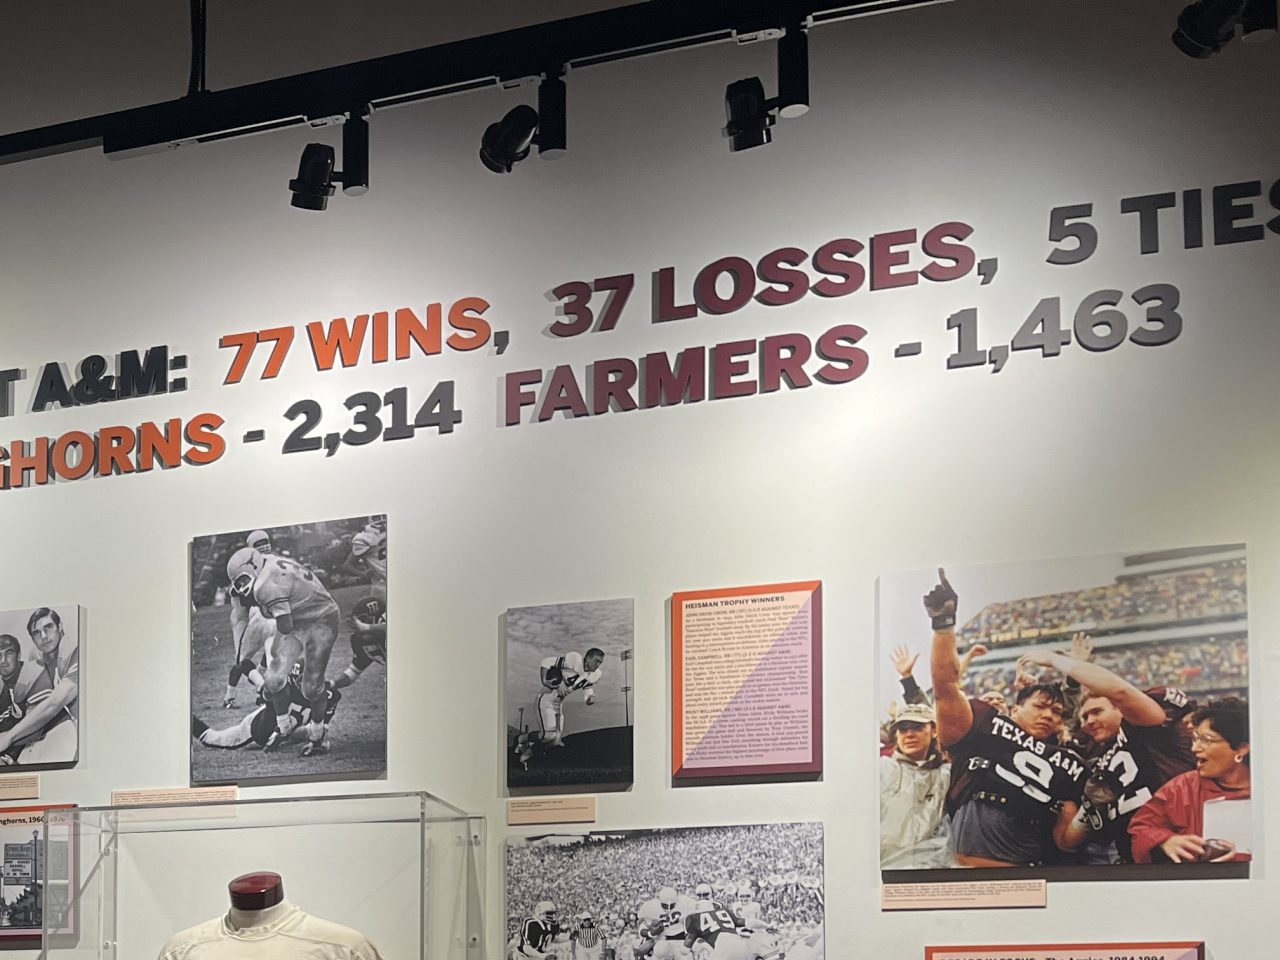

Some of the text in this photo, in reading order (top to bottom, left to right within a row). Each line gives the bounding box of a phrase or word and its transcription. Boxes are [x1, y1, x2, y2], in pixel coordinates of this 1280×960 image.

[32, 345, 187, 412] A&M:
[220, 326, 294, 385] 77
[309, 297, 509, 371] WINS,
[548, 274, 634, 338] 37
[653, 222, 998, 323] LOSSES,
[1047, 203, 1097, 265] 5
[1121, 180, 1280, 255] TIE
[282, 381, 461, 457] 2,314
[504, 324, 868, 427] FARMERS
[946, 283, 1183, 373] 1,463
[685, 595, 785, 610] HEISMAN TROPHY WINNERS
[991, 716, 1046, 756] TEXAS
[1048, 751, 1084, 782] A&M
[699, 910, 737, 933] 49
